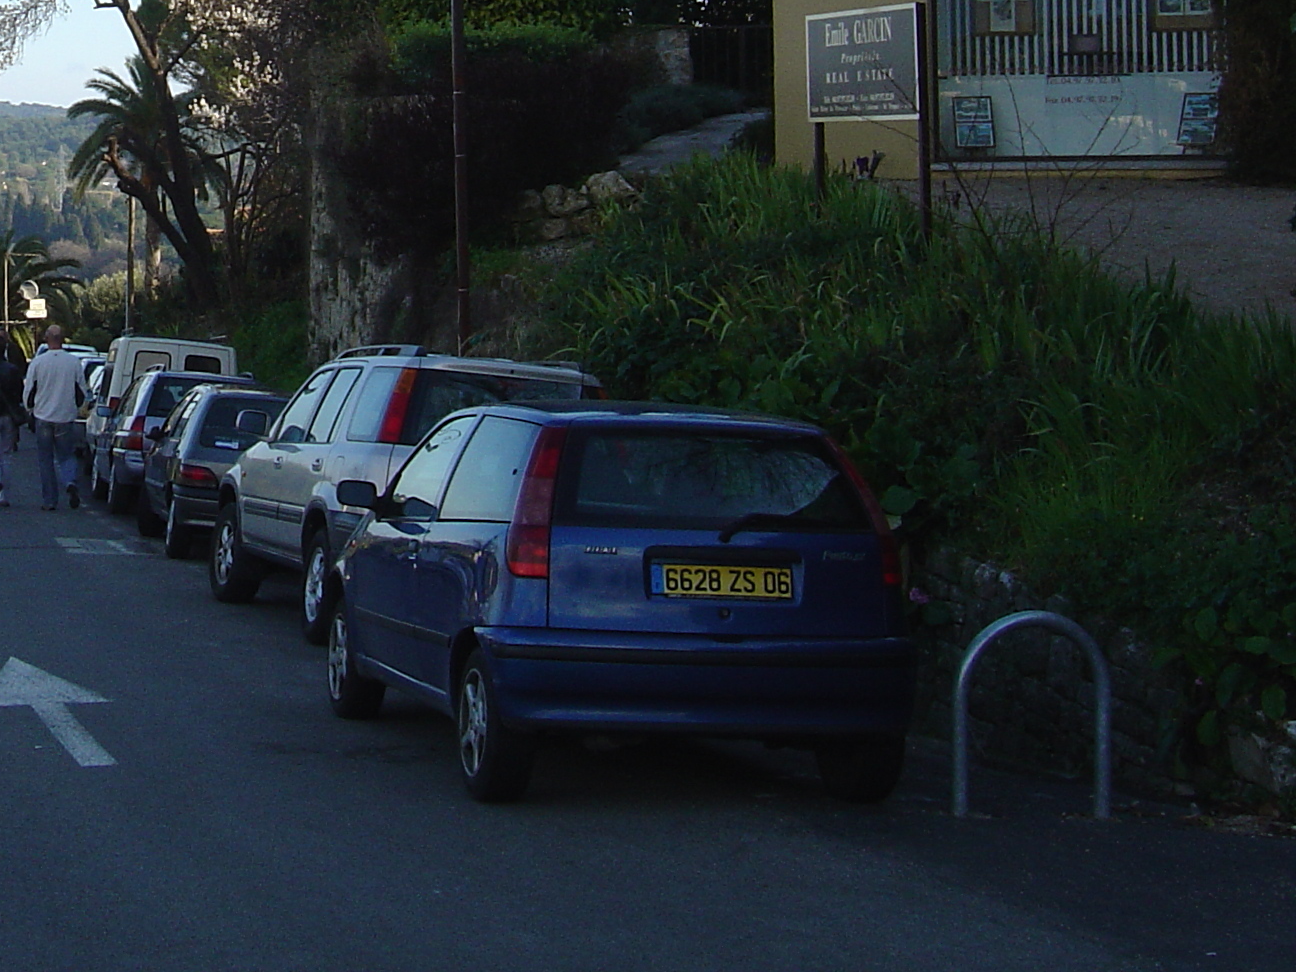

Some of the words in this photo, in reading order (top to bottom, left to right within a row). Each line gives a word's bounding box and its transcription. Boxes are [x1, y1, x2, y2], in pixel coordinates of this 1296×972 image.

[825, 22, 850, 47] Emile
[853, 16, 893, 45] GARCIN
[826, 72, 849, 83] REAL
[857, 68, 894, 82] ESTATE
[665, 568, 721, 592] 6628
[729, 570, 756, 593] ZS
[763, 571, 791, 594] 06
